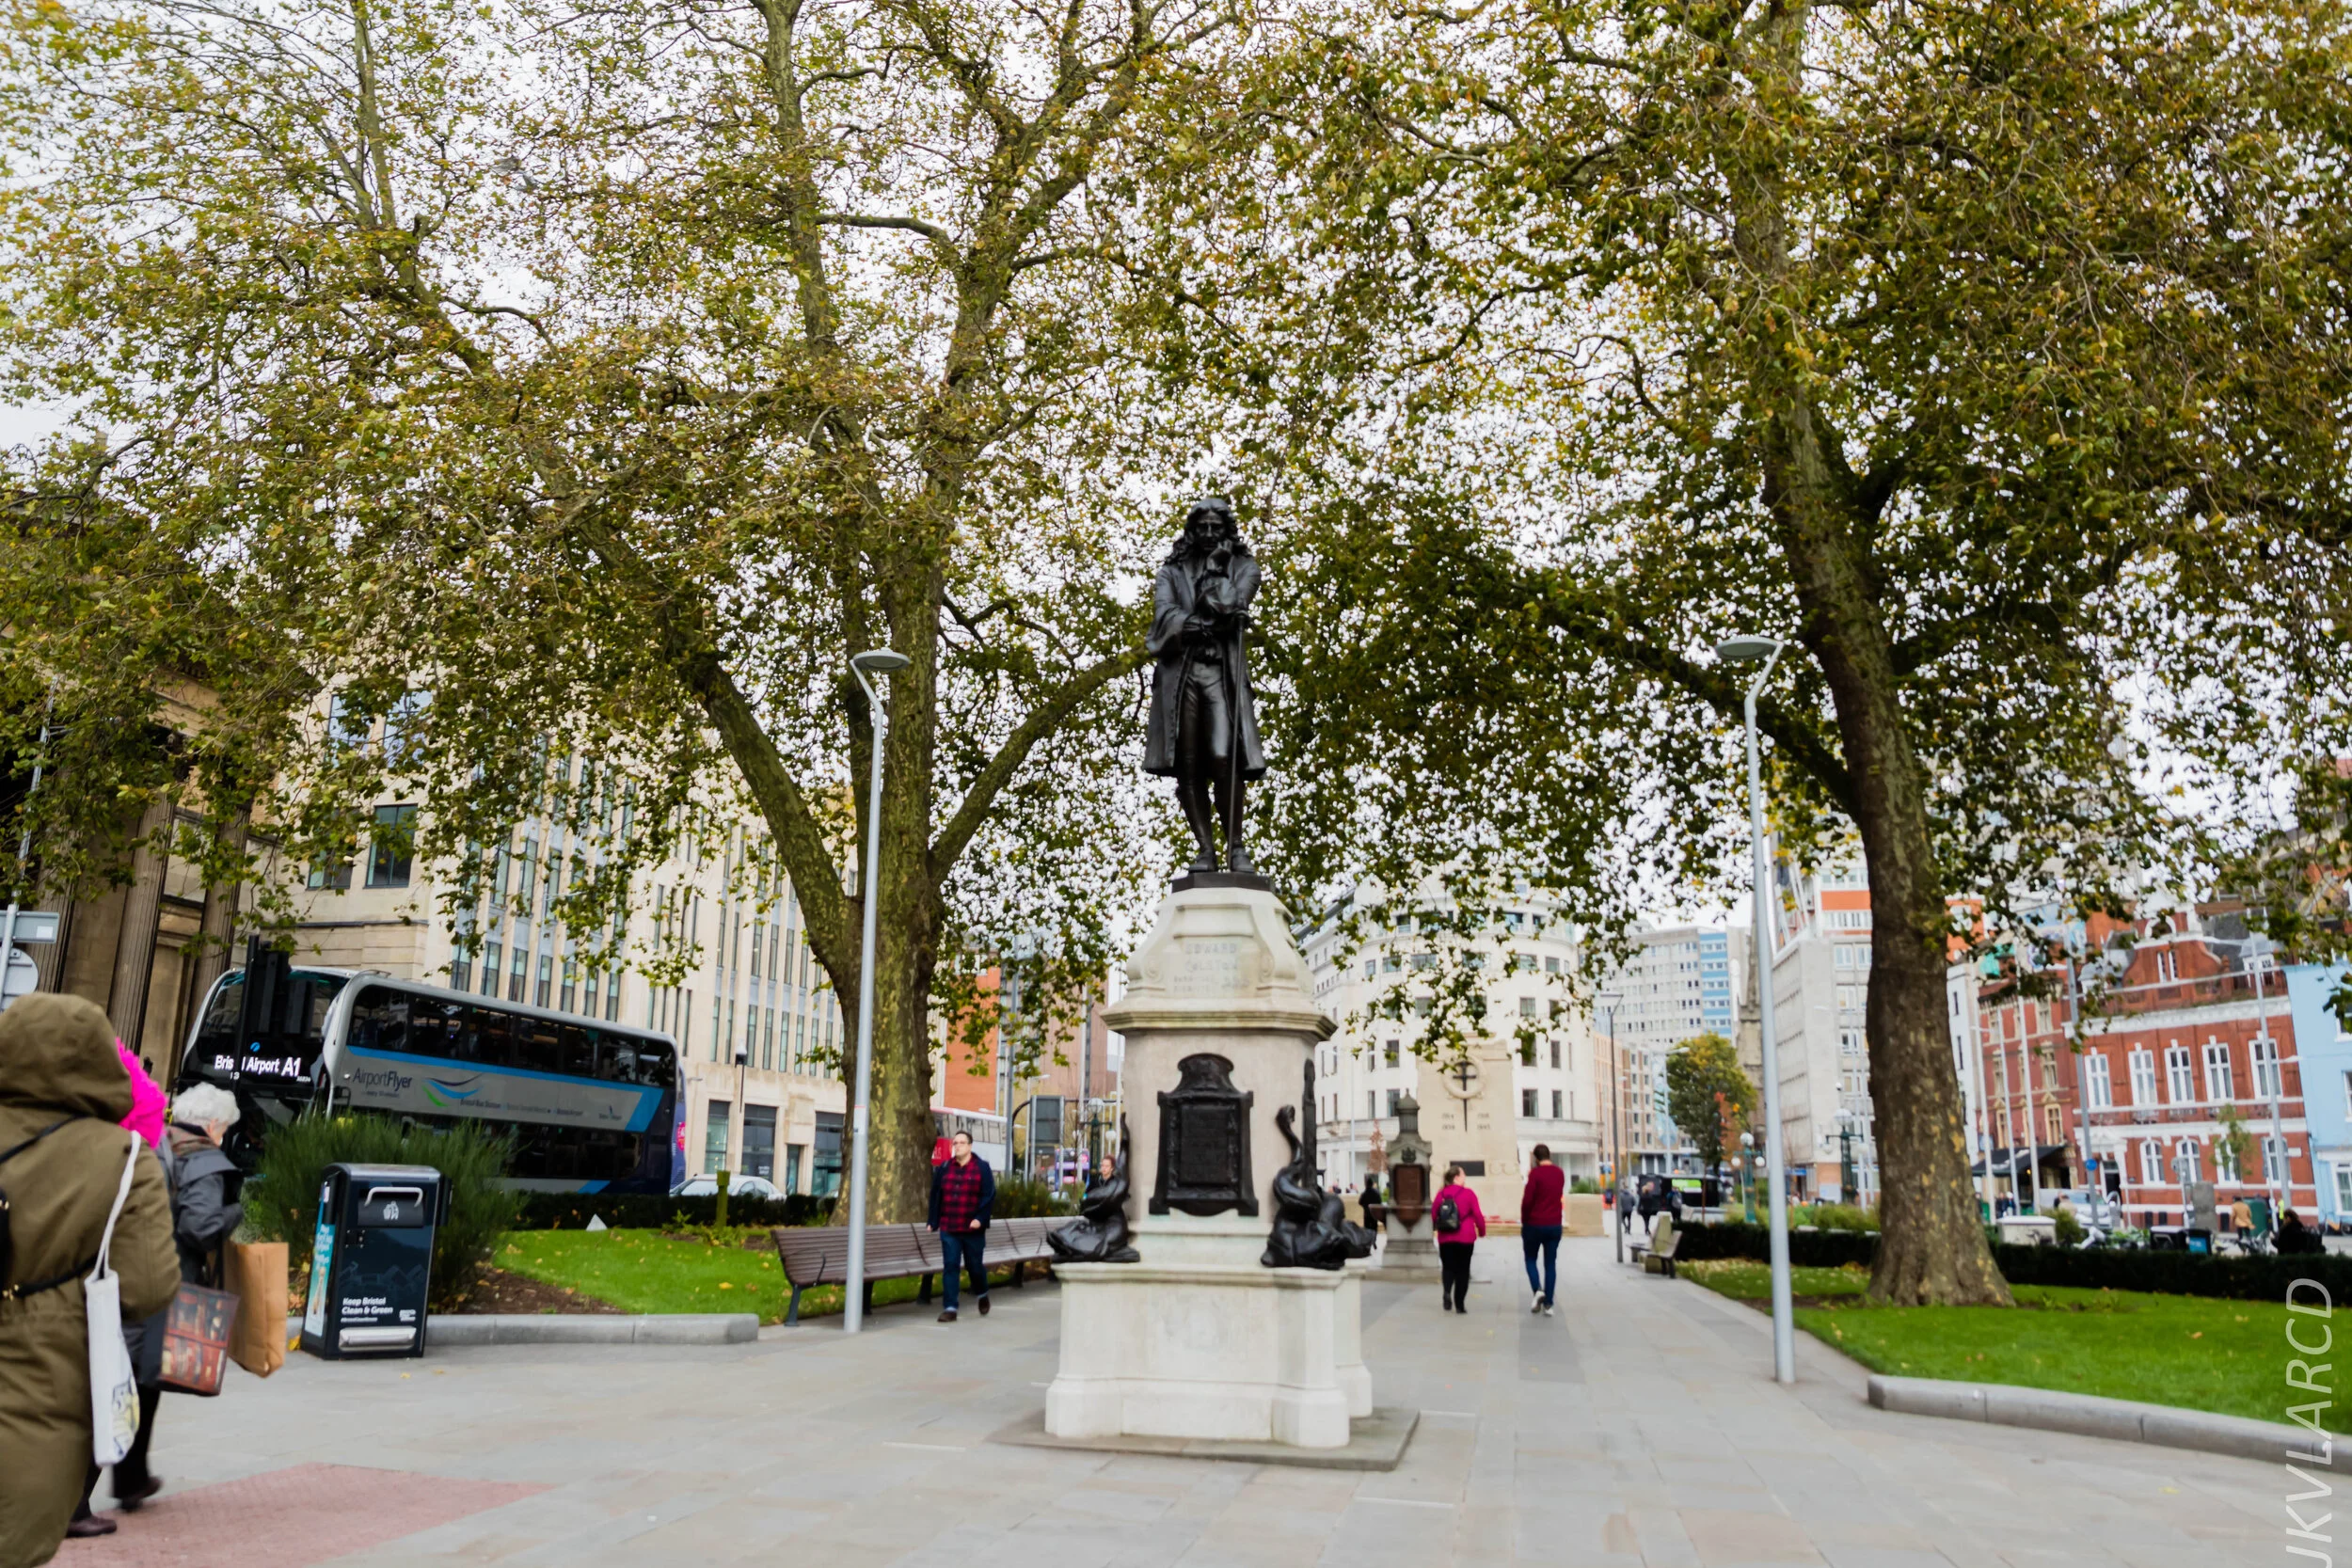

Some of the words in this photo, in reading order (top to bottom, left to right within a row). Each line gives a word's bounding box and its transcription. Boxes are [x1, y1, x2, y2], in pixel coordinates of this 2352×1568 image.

[215, 1054, 246, 1071] Brisl
[246, 1057, 280, 1076] Airport
[281, 1056, 301, 1077] A1
[353, 1068, 413, 1092] AirportFlyer
[342, 1297, 361, 1307] Keep
[362, 1296, 387, 1306] Bristol
[342, 1306, 363, 1315] Clean
[371, 1306, 393, 1314] Green
